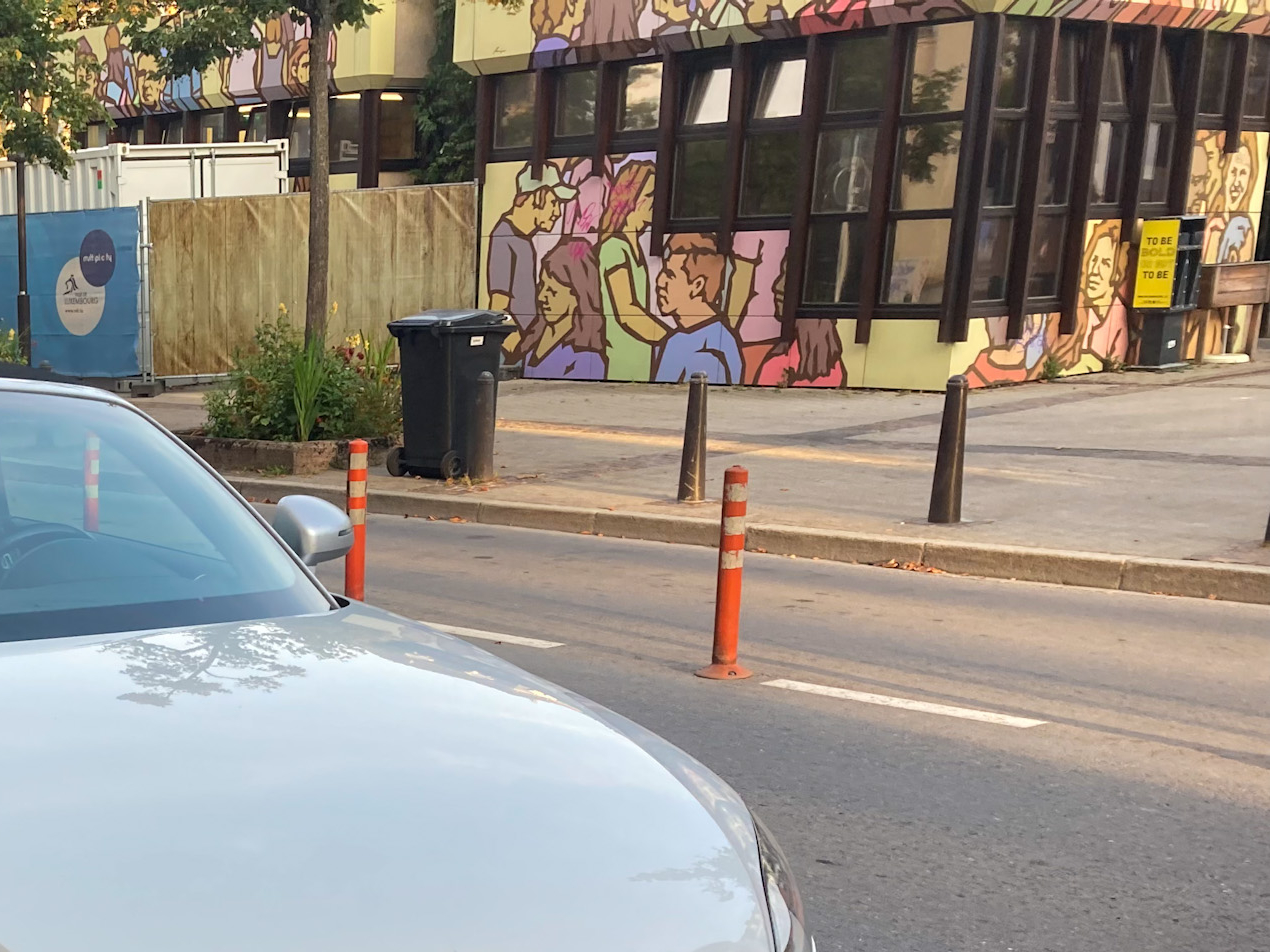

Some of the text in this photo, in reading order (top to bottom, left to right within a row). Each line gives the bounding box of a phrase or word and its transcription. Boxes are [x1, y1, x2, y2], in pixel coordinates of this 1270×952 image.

[1146, 236, 1173, 245] TO BE
[1143, 271, 1169, 279] TO BE
